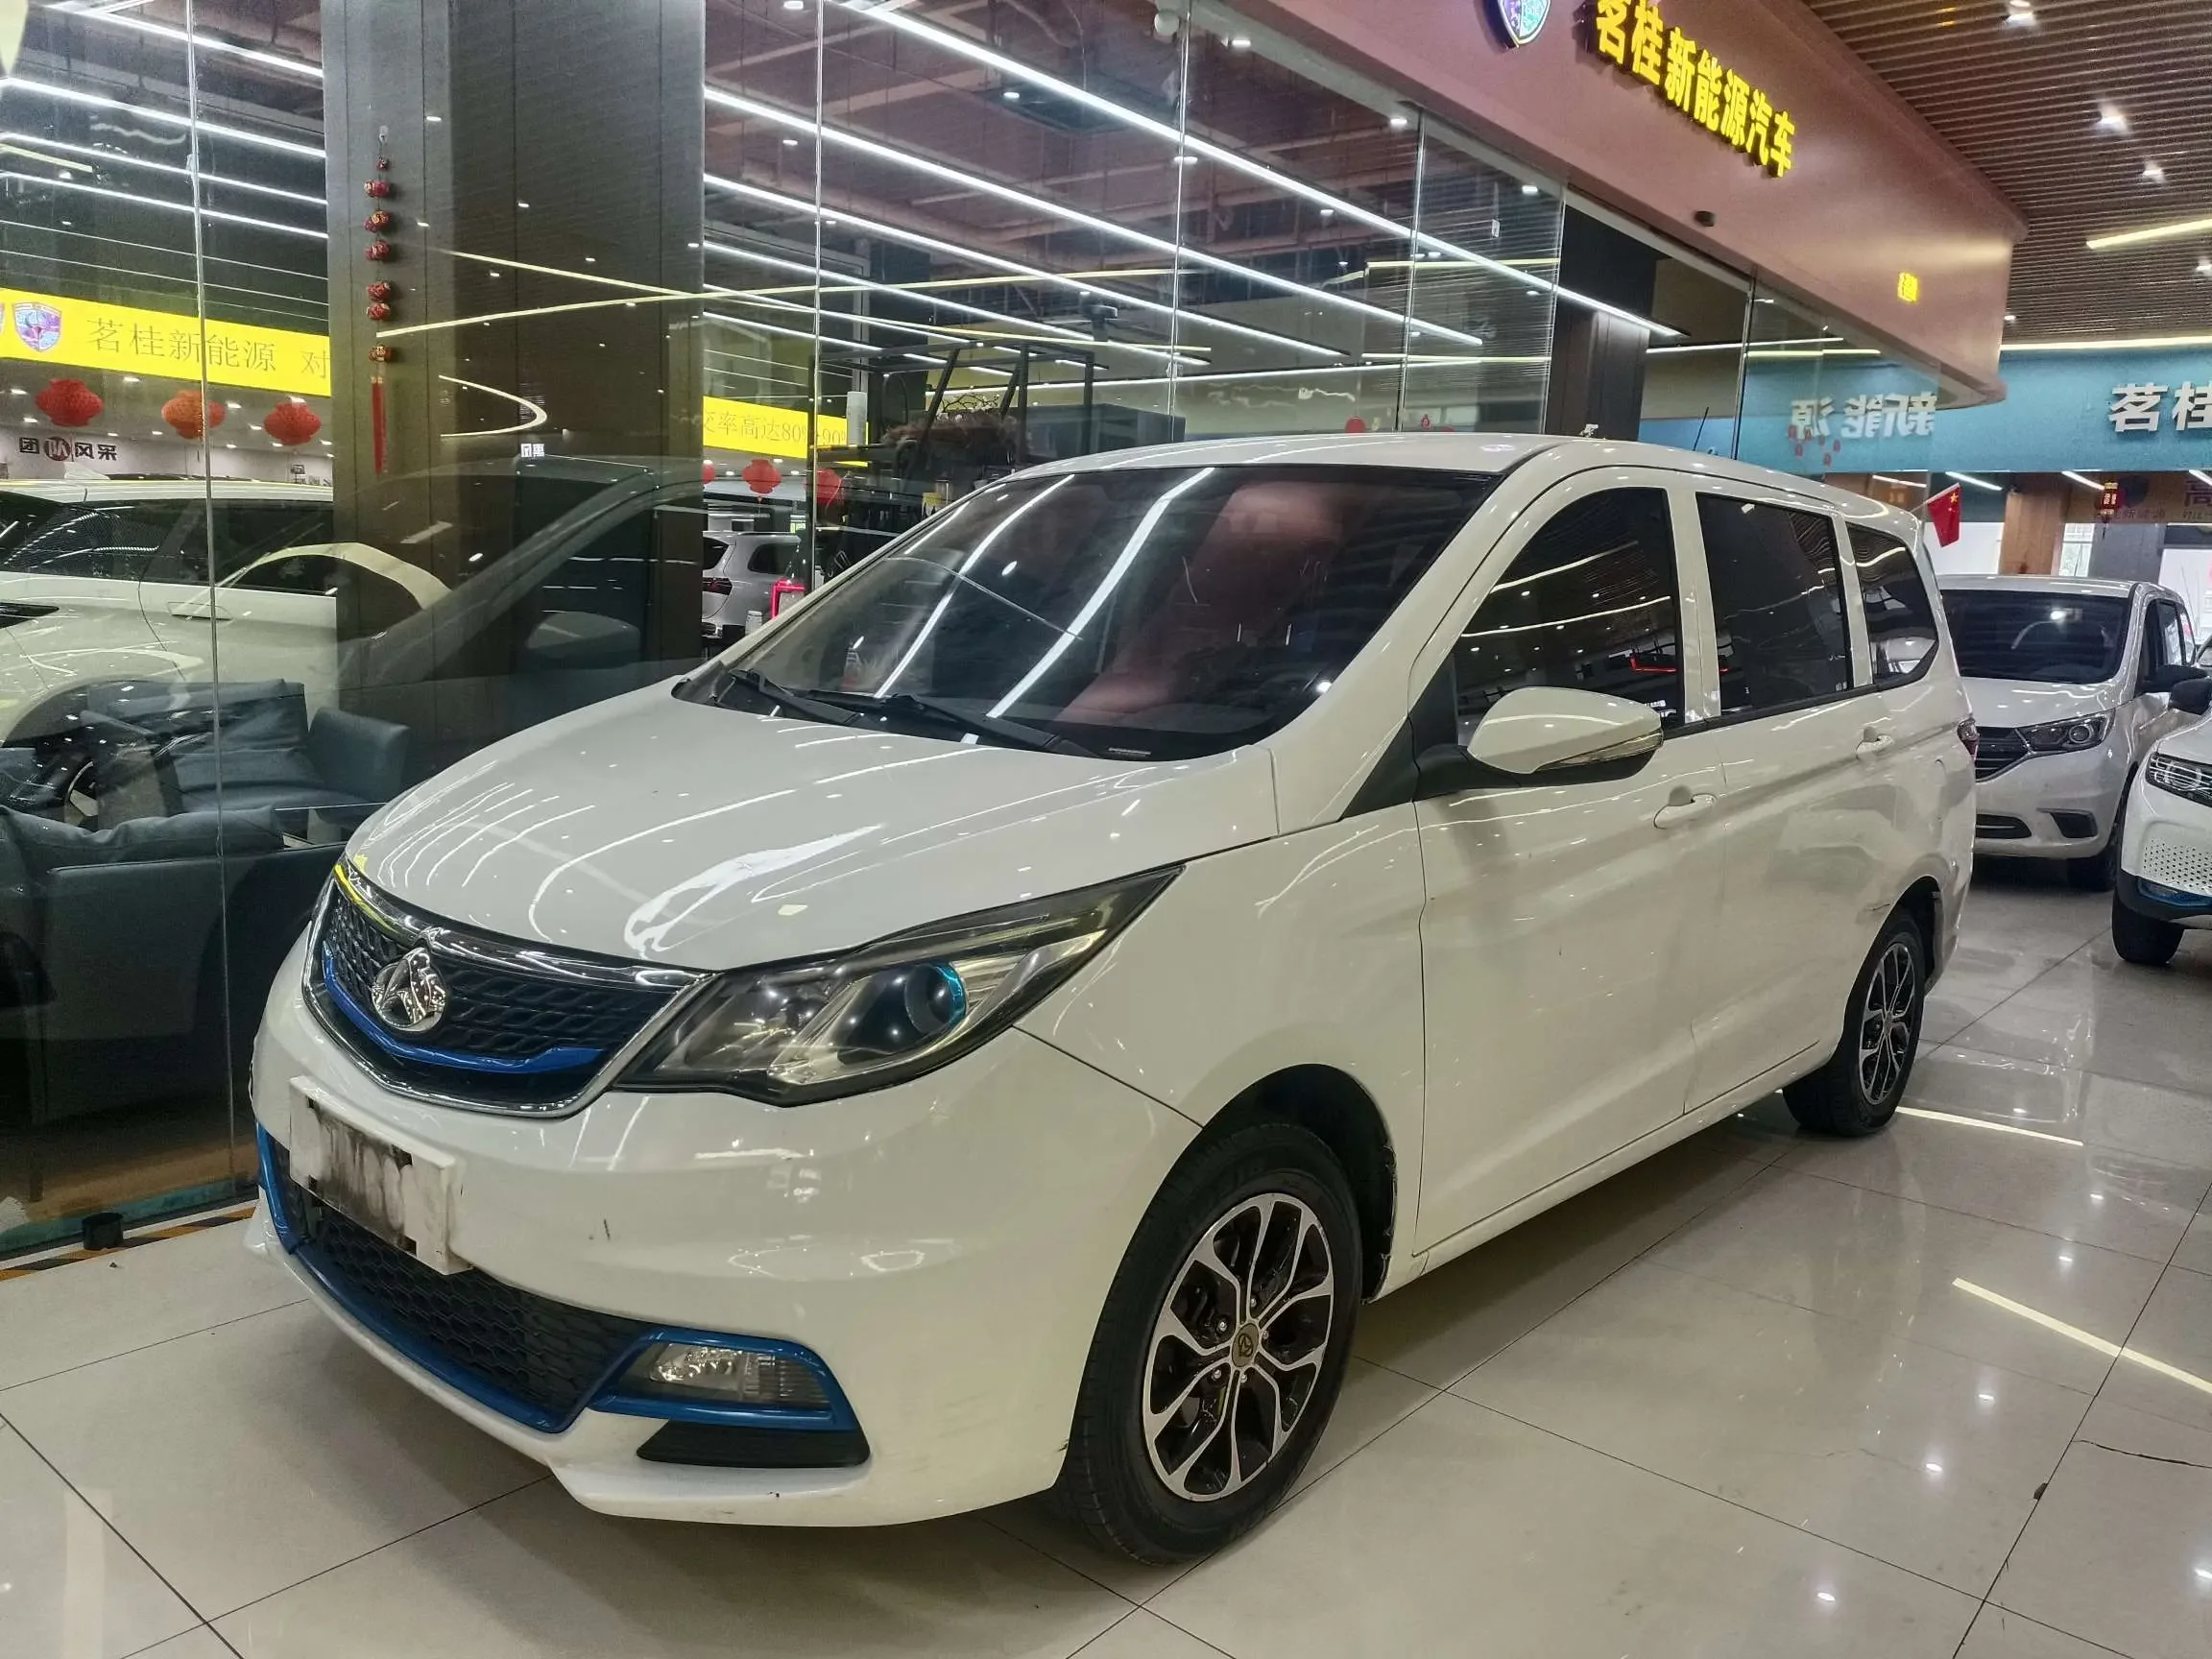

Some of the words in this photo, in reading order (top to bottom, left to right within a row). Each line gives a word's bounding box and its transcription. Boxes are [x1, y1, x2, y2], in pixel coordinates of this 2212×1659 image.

[1596, 0, 1795, 178] 茗桂新能源汽车
[86, 316, 276, 373] 茗桂新能源
[2108, 381, 2212, 432] 茗桂
